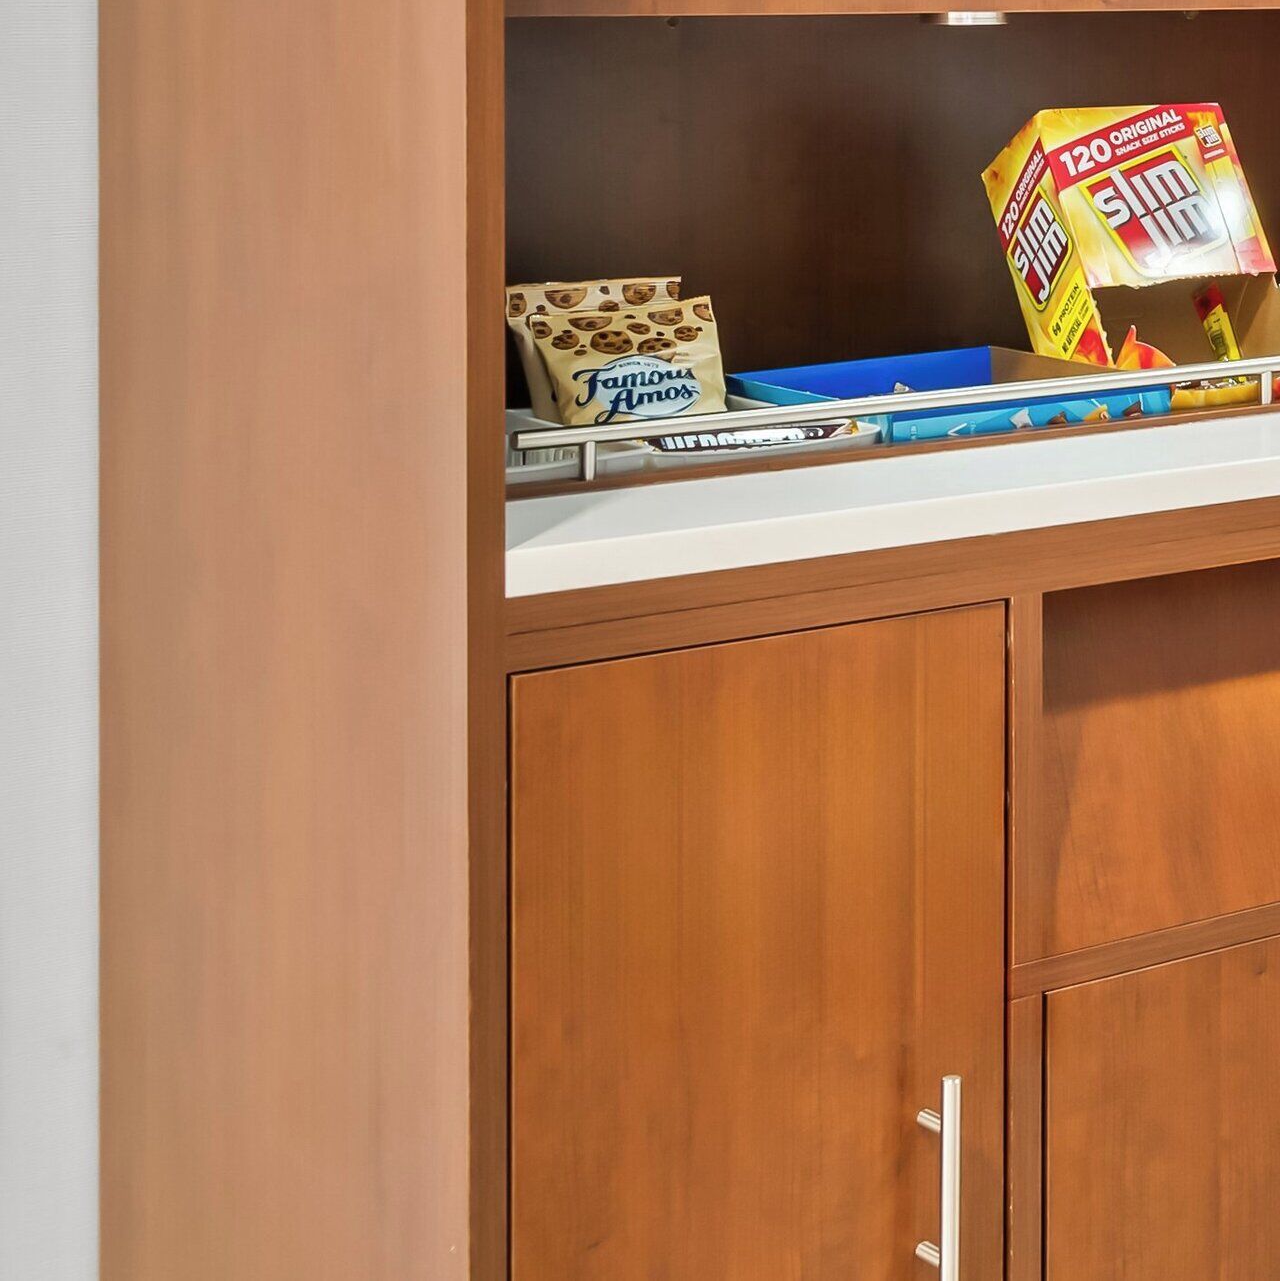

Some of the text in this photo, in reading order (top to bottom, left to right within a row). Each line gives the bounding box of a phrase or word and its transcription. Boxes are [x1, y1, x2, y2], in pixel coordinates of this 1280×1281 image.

[1059, 109, 1183, 177] 120 ORIGINAL
[1115, 123, 1186, 157] SNACK SIZE STICKS
[1001, 149, 1044, 240] 120 ORIGINAL
[1058, 283, 1080, 324] PROTEIN
[572, 366, 697, 408] Famous
[595, 383, 700, 424] Amos
